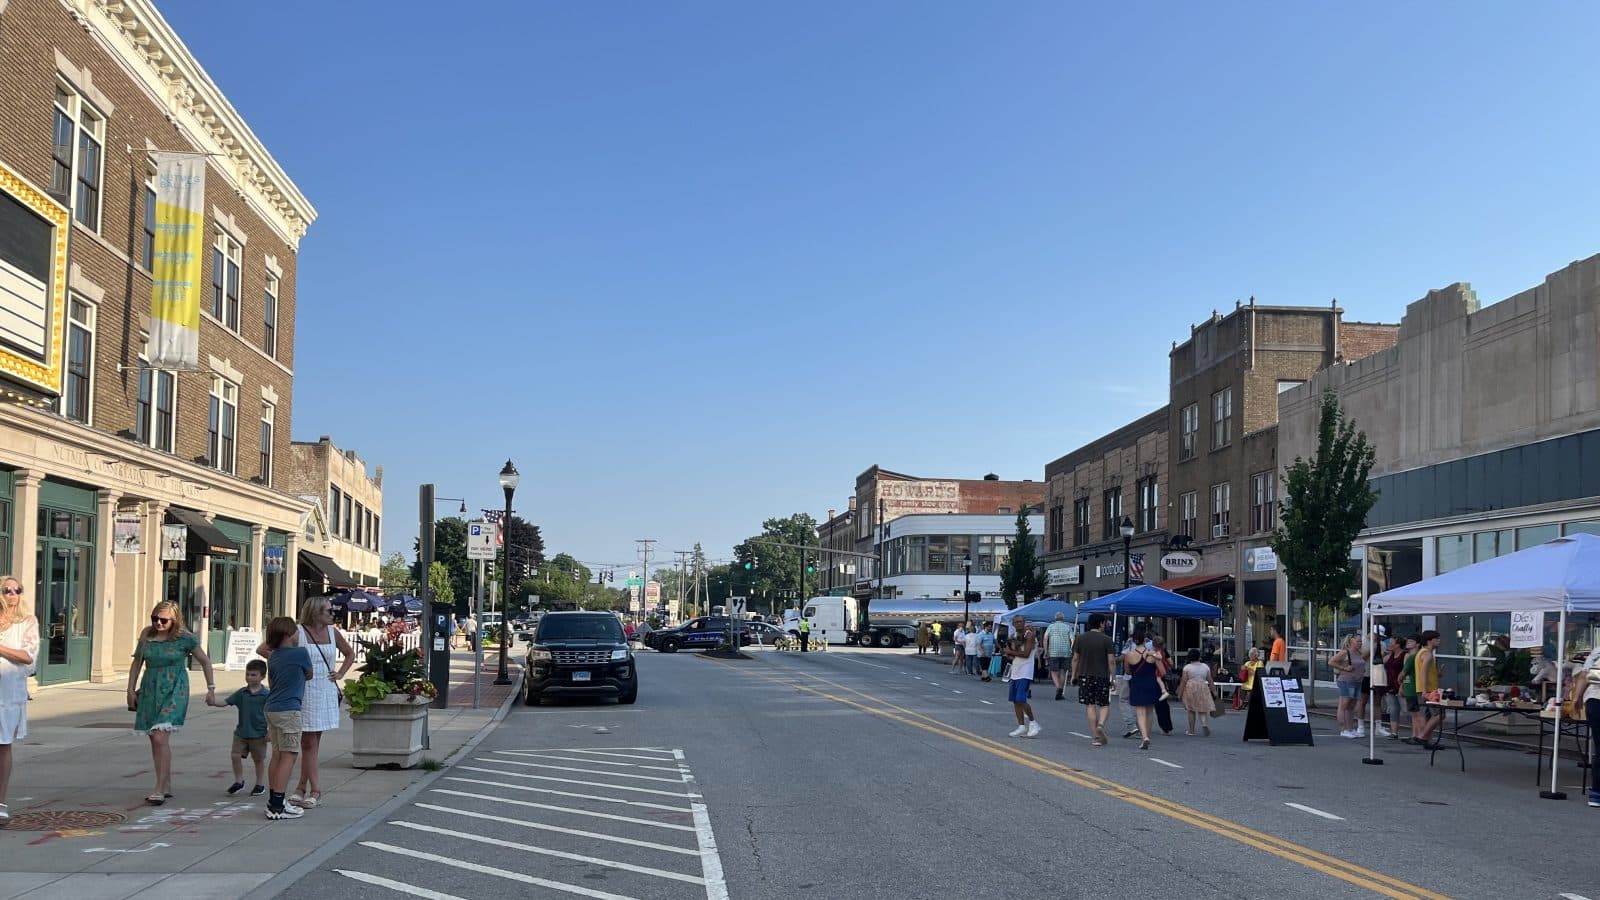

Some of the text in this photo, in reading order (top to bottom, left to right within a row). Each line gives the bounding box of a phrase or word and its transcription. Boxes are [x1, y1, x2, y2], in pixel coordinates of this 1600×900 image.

[881, 484, 956, 498] HOWARD'S
[472, 526, 479, 535] P
[1165, 558, 1194, 566] BRINX
[438, 615, 445, 625] P
